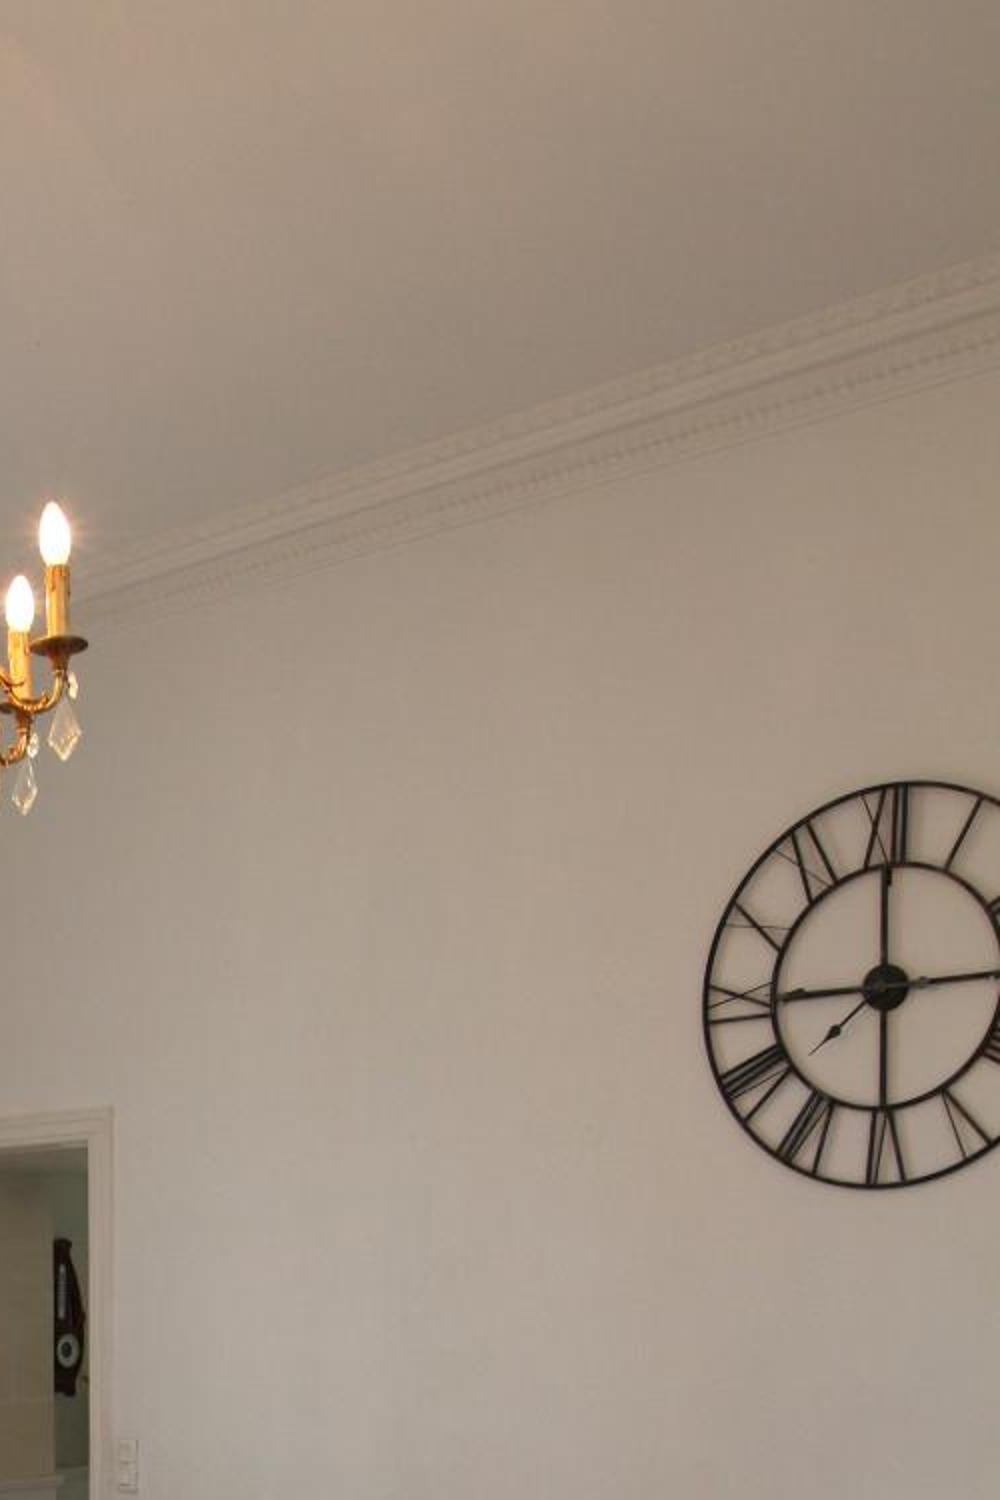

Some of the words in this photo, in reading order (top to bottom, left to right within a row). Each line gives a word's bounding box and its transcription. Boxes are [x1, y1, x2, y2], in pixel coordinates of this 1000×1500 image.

[774, 820, 838, 901] XI
[861, 785, 909, 869] XII
[944, 798, 984, 871] I
[725, 902, 795, 952] X
[707, 981, 774, 1024] IX
[720, 1043, 794, 1125] VIII
[777, 1090, 834, 1175] VII
[866, 1108, 906, 1185] VI
[941, 1088, 992, 1159] V
